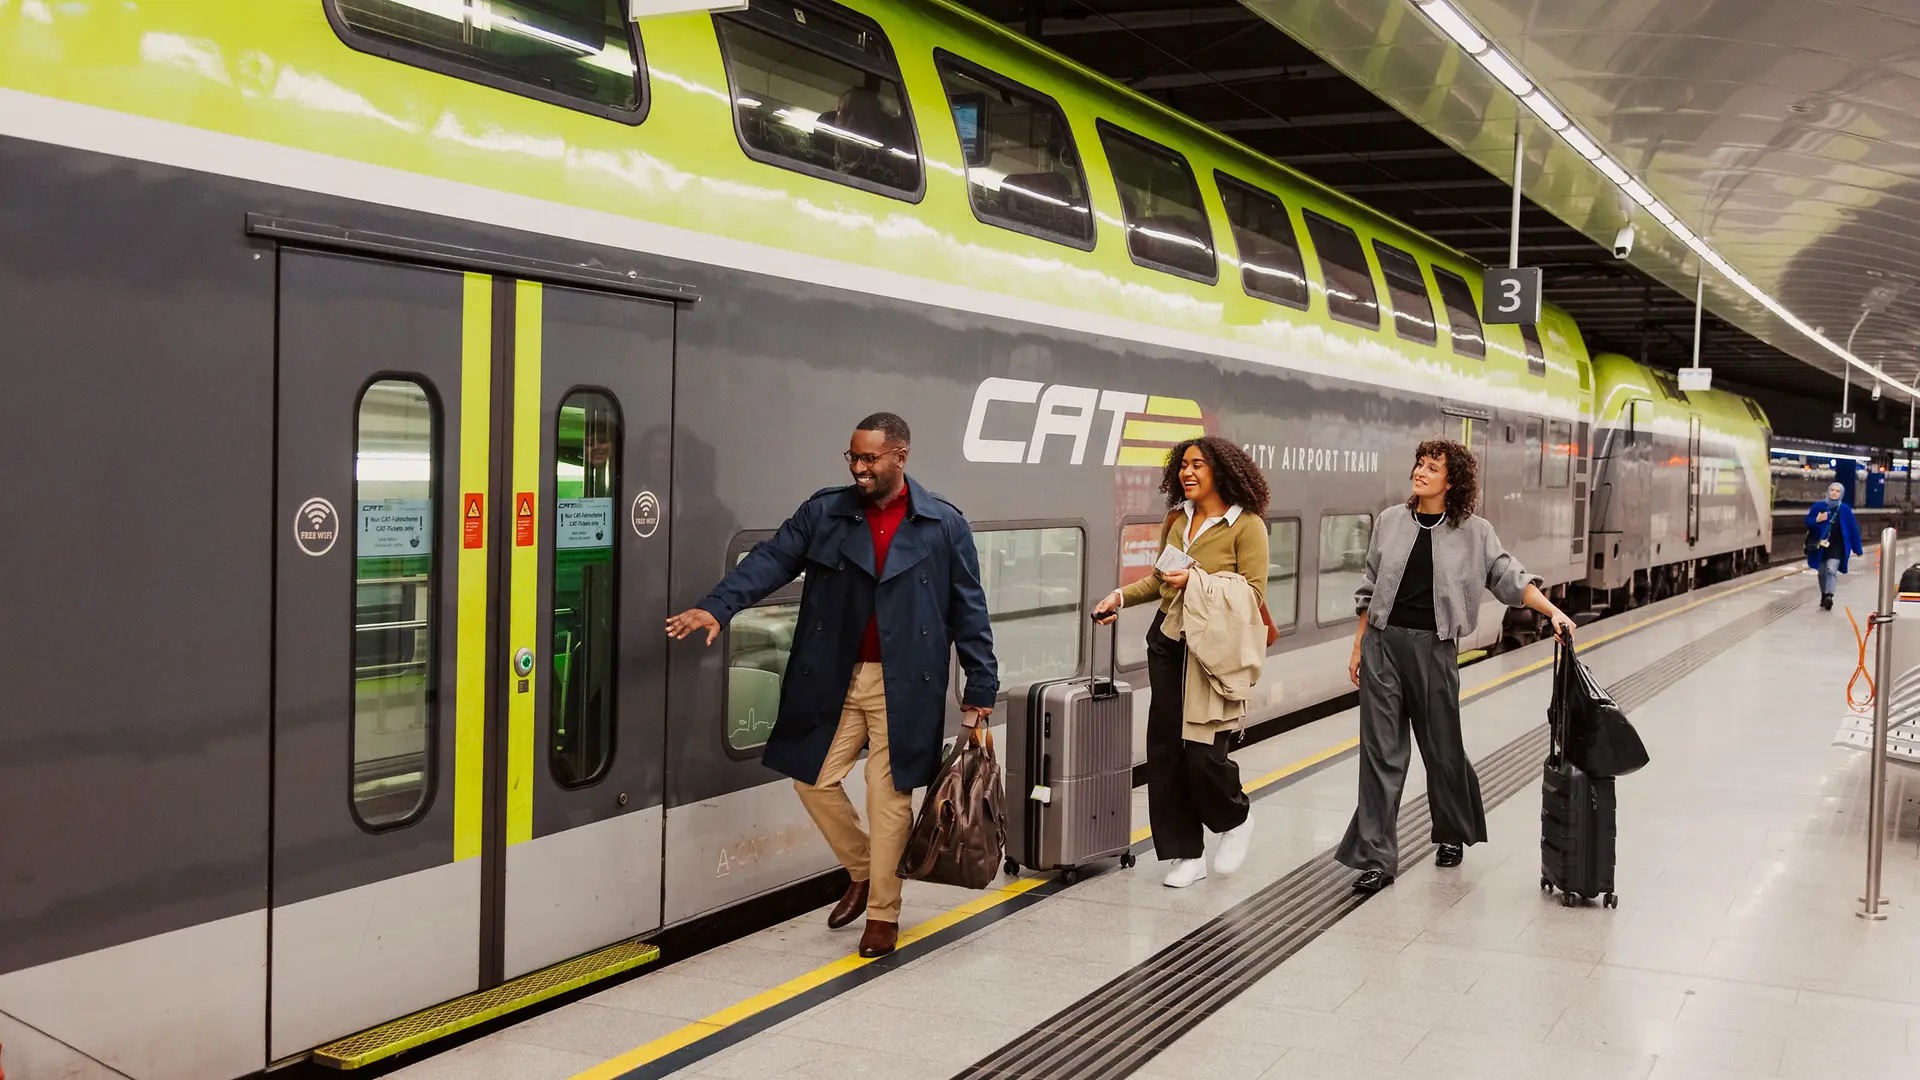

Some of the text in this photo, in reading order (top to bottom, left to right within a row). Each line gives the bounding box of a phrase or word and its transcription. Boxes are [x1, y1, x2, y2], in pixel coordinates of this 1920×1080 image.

[1498, 278, 1522, 313] 3
[962, 376, 1149, 466] CAT
[1834, 417, 1853, 429] 3D
[1281, 446, 1339, 472] AIRPORT
[1344, 450, 1379, 473] TRAIN
[300, 531, 333, 540] FREE WIFI
